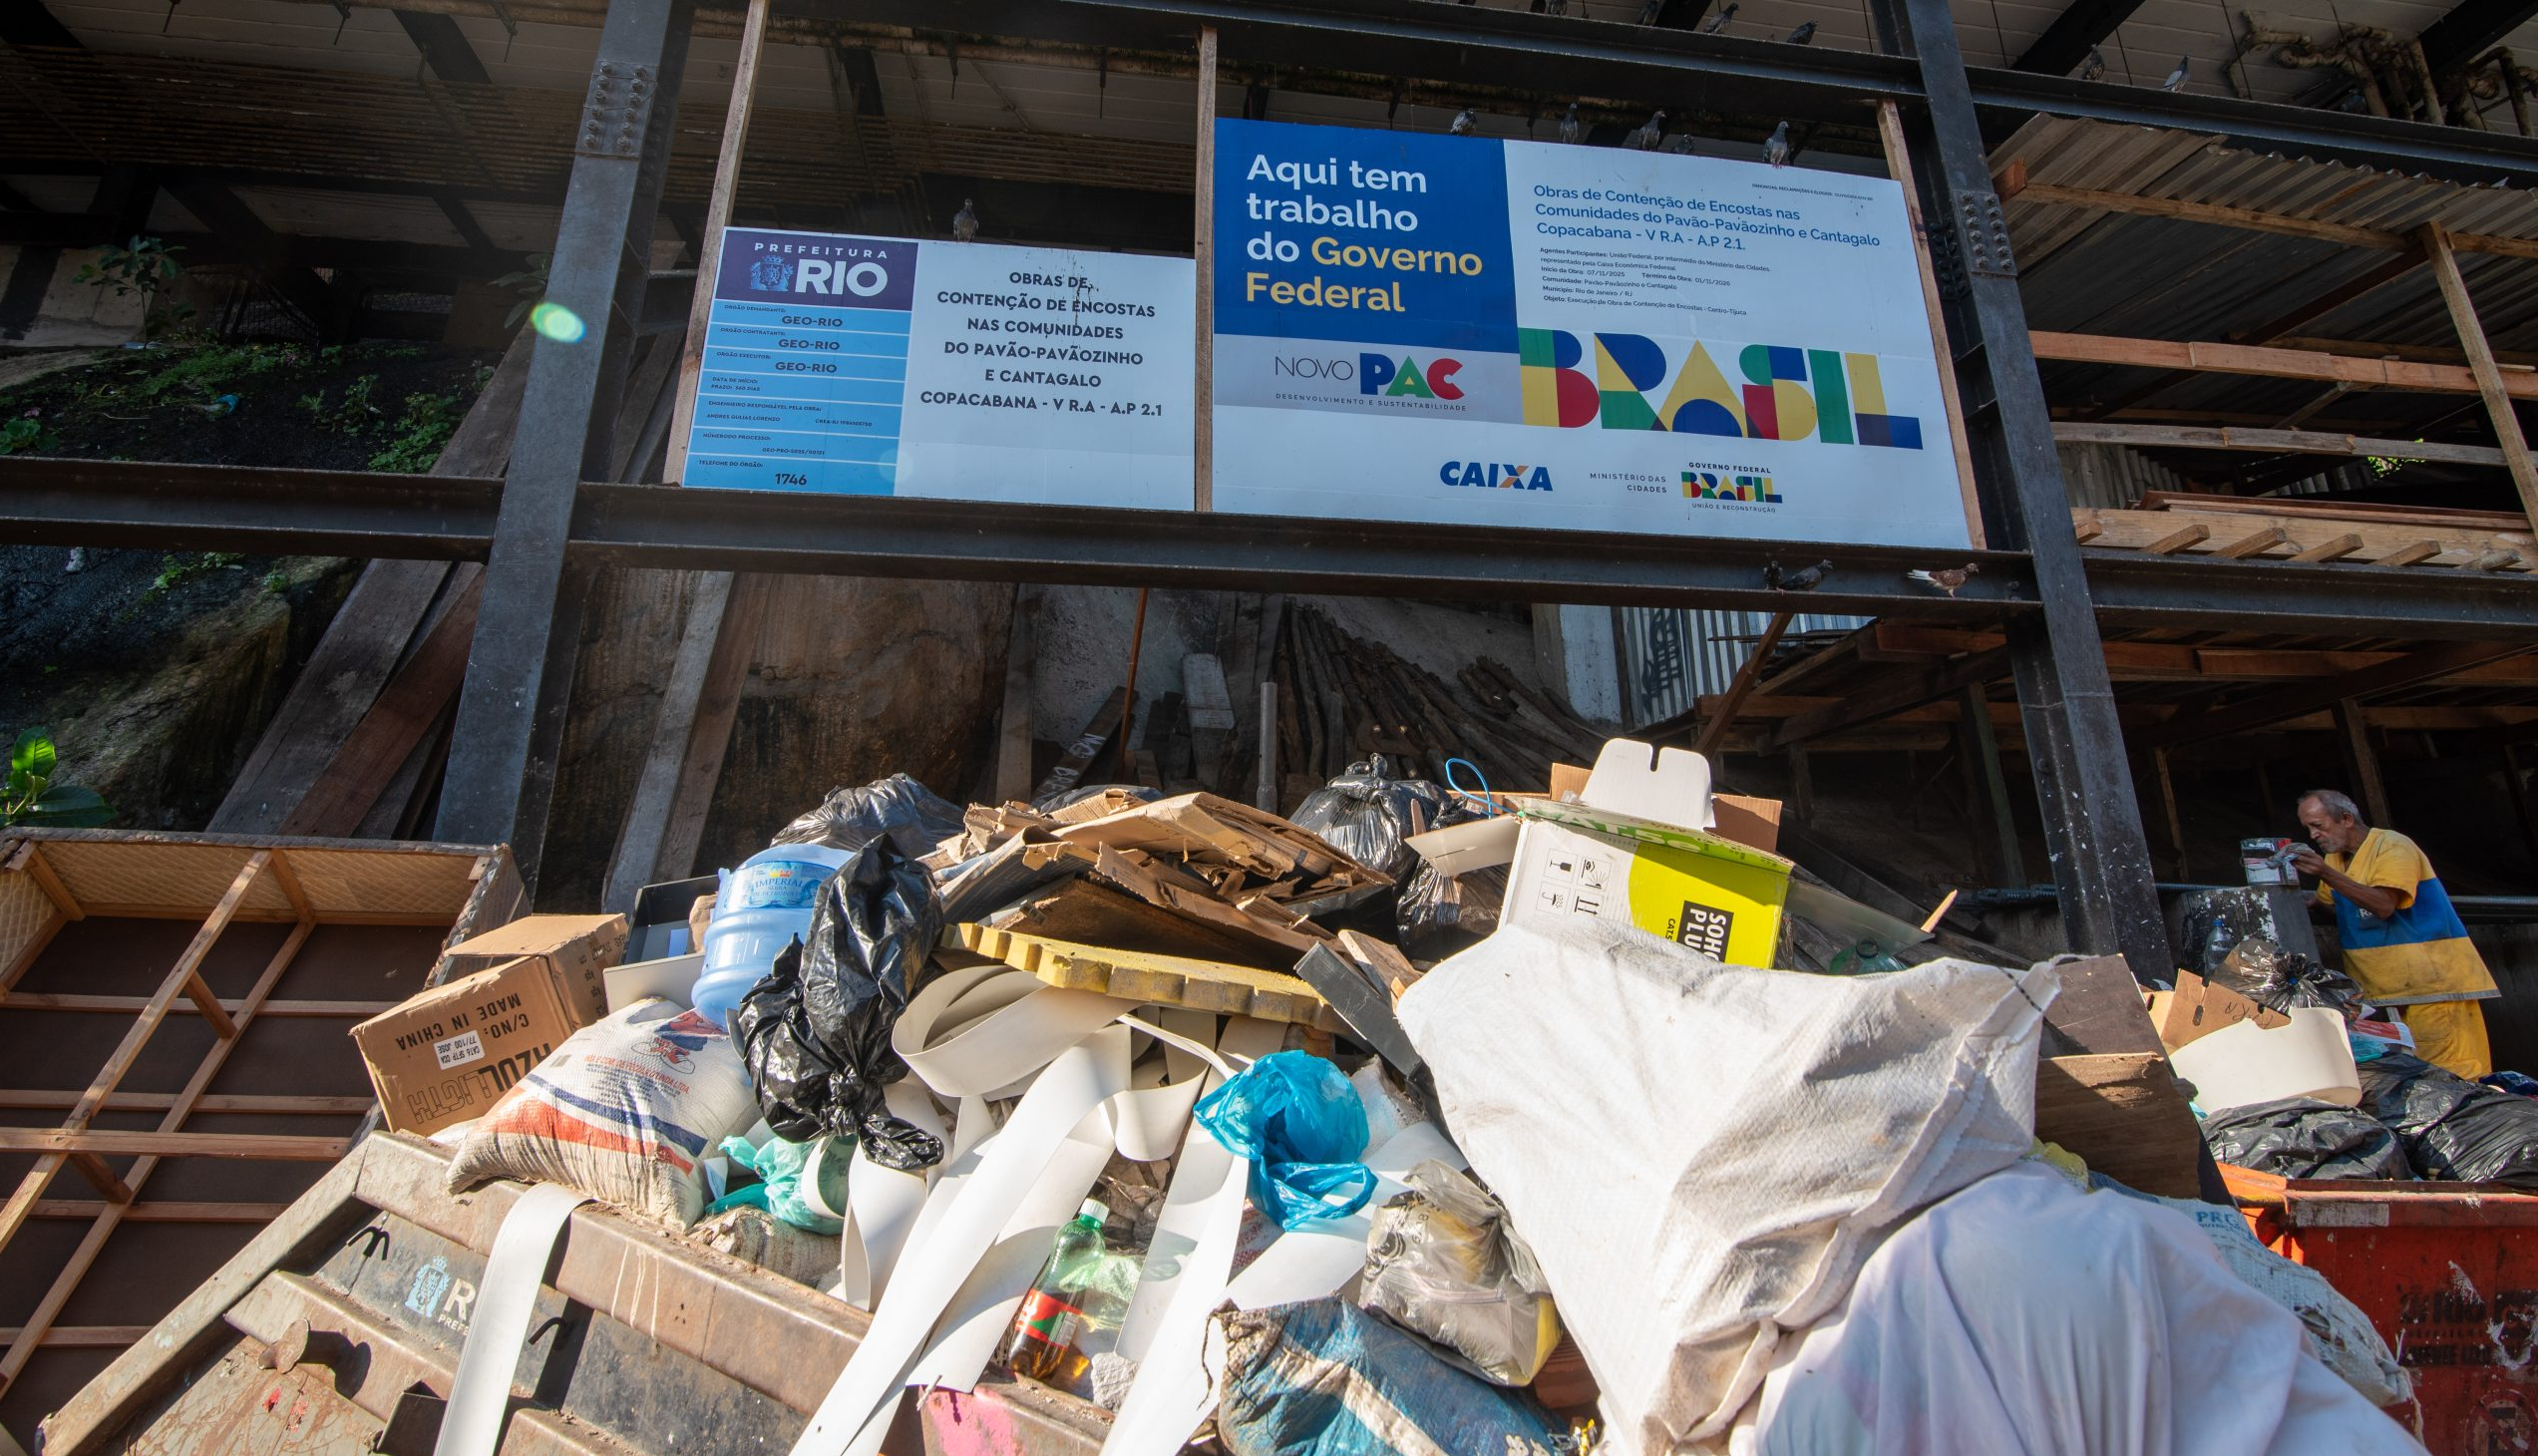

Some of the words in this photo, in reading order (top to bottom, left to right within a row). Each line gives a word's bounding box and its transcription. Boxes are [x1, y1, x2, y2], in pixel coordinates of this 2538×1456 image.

[1247, 154, 1337, 190] Aqui
[1349, 161, 1427, 192] tem
[1247, 192, 1418, 231] trabalho
[1534, 184, 1579, 199] Obras
[1582, 188, 1602, 200] de
[1605, 190, 1683, 209] Contenção
[1687, 198, 1706, 210] de
[1710, 200, 1772, 217] Encostas
[1776, 209, 1800, 220] nas
[1535, 203, 1639, 221] Comunidades
[1643, 210, 1661, 223] do
[1665, 213, 1795, 237] Pavão-Pavãozinho
[1798, 228, 1807, 238] e
[1810, 228, 1880, 247] Cantagalo
[1537, 222, 1632, 239] Copacabana
[1645, 230, 1655, 240] V
[1660, 230, 1683, 243] R.A
[1697, 235, 1719, 246] A.P
[755, 242, 888, 259] PREFEITURA
[1247, 231, 1300, 262] do
[1311, 236, 1483, 276] Governo
[795, 258, 888, 296] RIO
[1009, 271, 1063, 287] OBRAS
[1067, 276, 1088, 289] DE
[936, 291, 1041, 310] CONTENÇÃO
[1047, 299, 1066, 311] DE
[1072, 300, 1156, 317] ENCOSTAS
[1247, 271, 1405, 313] Federal
[782, 315, 843, 327] GEO-RIO
[967, 318, 999, 332] NAS
[1004, 320, 1123, 339] COMUNIDADES
[779, 339, 840, 350] GEO-RIO
[944, 341, 968, 354] DO
[974, 341, 1144, 365] PAVÃO-PAVÃOZINHO
[775, 361, 838, 373] GEO-RIO
[985, 369, 994, 381] E
[999, 370, 1102, 388] CANTAGALO
[1274, 355, 1353, 381] NOVO
[1359, 352, 1465, 400] PAC
[1518, 326, 1924, 450] BRASIL
[920, 391, 1037, 410] COPACABANA
[1053, 399, 1065, 411] V
[1069, 400, 1095, 413] R.A
[1110, 402, 1136, 415] A.P
[1141, 404, 1162, 416] 2.1
[1275, 393, 1364, 405] DESENVOLVIMENTO
[1377, 400, 1467, 412] SUSTENTABILIDADE
[775, 473, 808, 486] 1746
[1439, 460, 1554, 492] CAIXA
[1590, 473, 1645, 482] MINISTÉRIO
[1688, 462, 1730, 471] GOVERNO
[1733, 465, 1771, 474] FEDERAL
[1627, 484, 1667, 494] CIDADES
[1680, 471, 1783, 504] BRASIL
[1722, 505, 1776, 514] RECONSTRUÇÃO
[1683, 908, 1706, 953] PLU
[477, 993, 522, 1021] MADE
[452, 1012, 470, 1029] IN
[484, 1013, 530, 1039] C/NO:
[396, 1022, 444, 1051] CHINA
